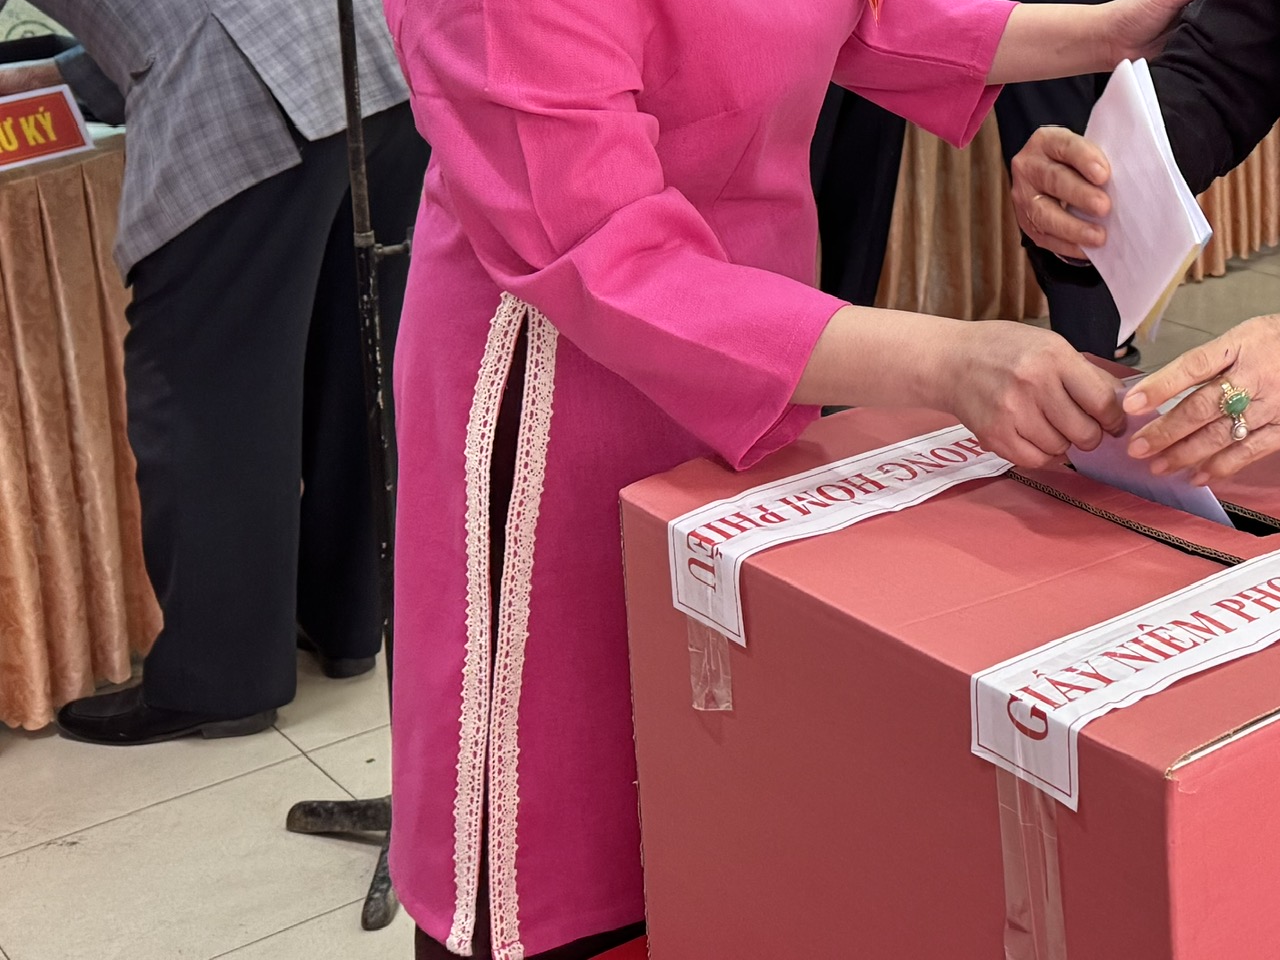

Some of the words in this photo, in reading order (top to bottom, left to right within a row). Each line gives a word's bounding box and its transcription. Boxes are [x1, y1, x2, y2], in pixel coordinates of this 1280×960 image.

[19, 106, 57, 146] KÝ
[877, 437, 984, 482] HONG
[776, 472, 889, 517] HÒM
[687, 504, 791, 593] PHIẾU
[1007, 660, 1120, 741] GIẤY
[1101, 610, 1238, 673] NIÊM
